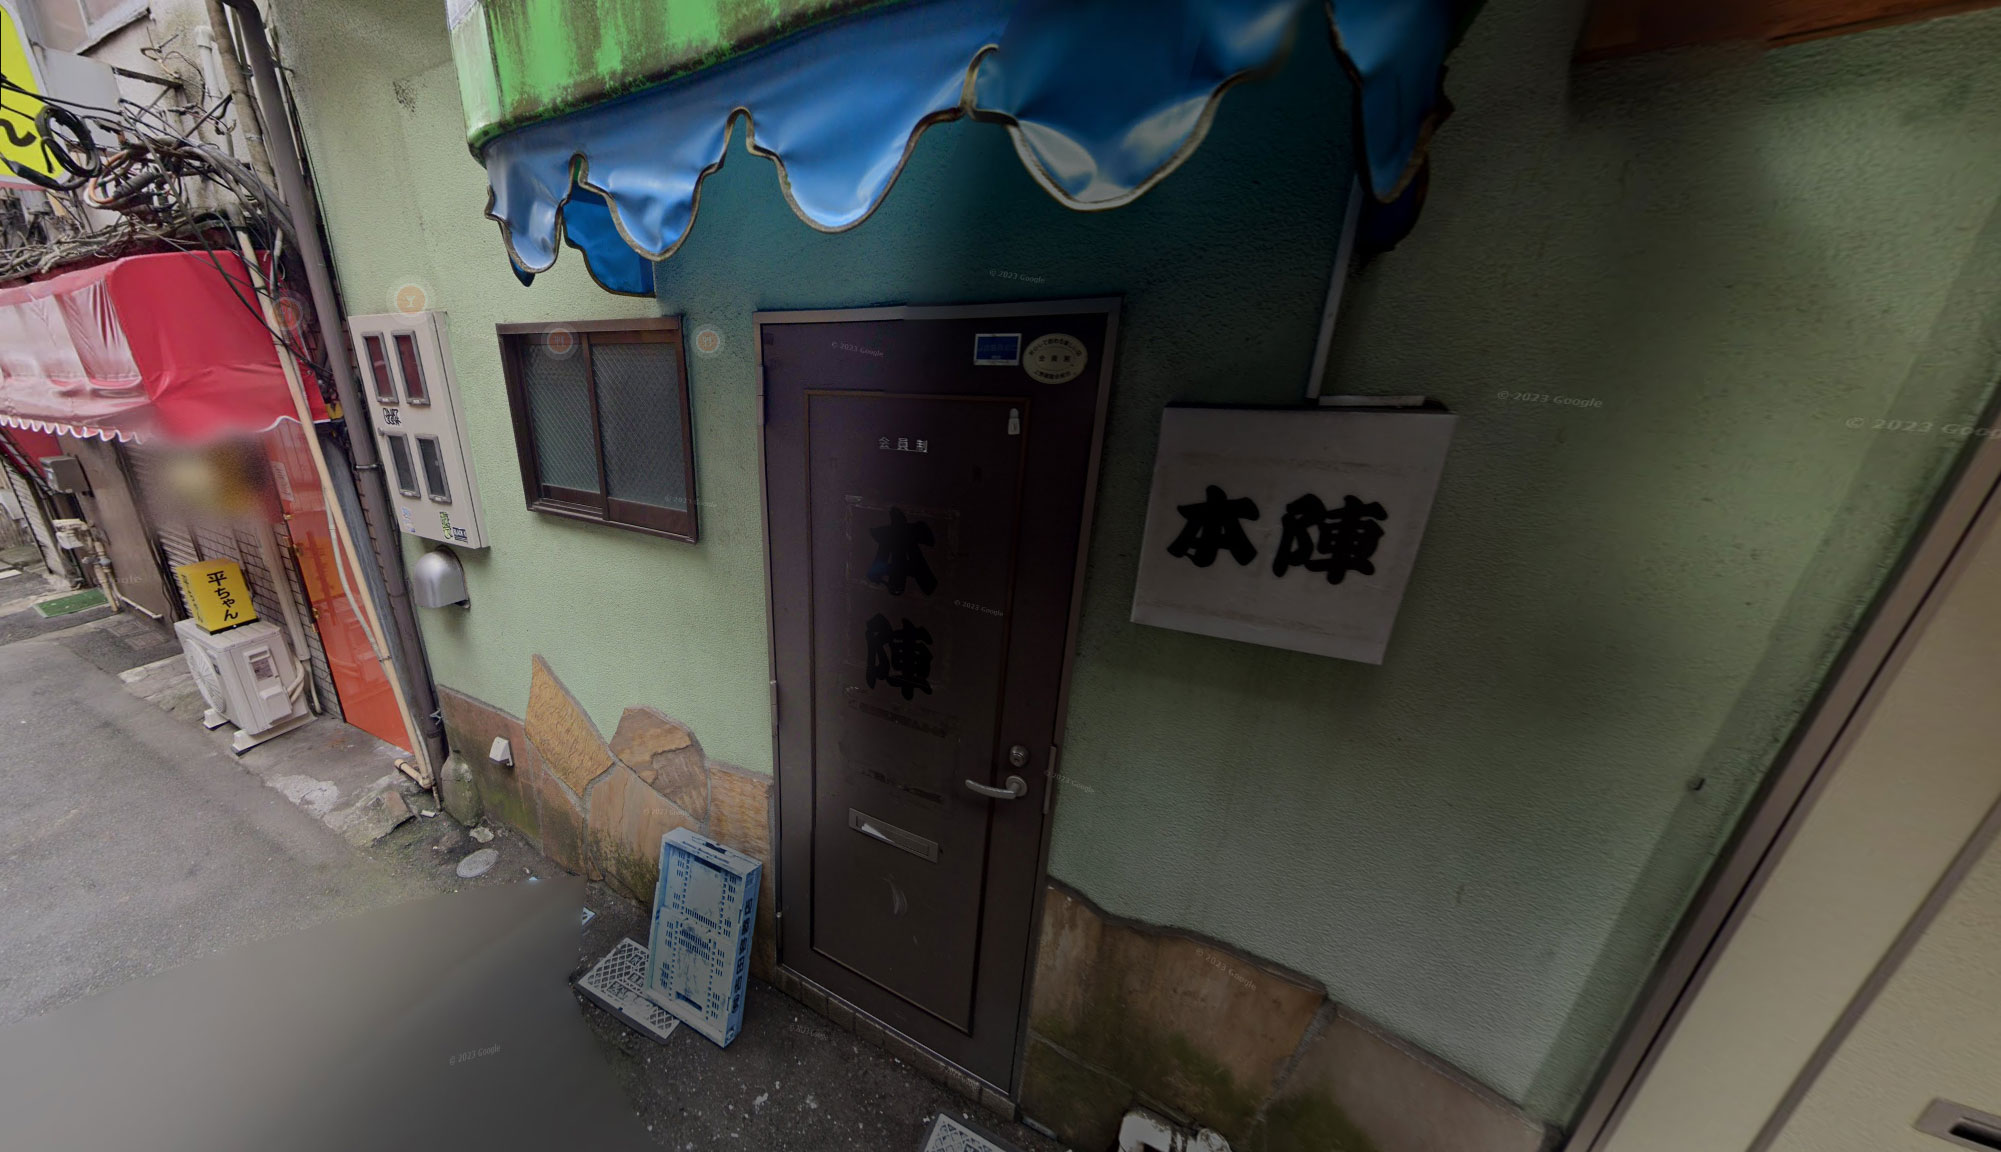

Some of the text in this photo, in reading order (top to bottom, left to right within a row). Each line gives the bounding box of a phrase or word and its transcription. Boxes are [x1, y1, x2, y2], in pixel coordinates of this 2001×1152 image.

[878, 436, 929, 453] 会員制
[1167, 485, 1388, 585] 本陣
[206, 570, 239, 621] 平ちゃん
[866, 506, 938, 701] 本陣
